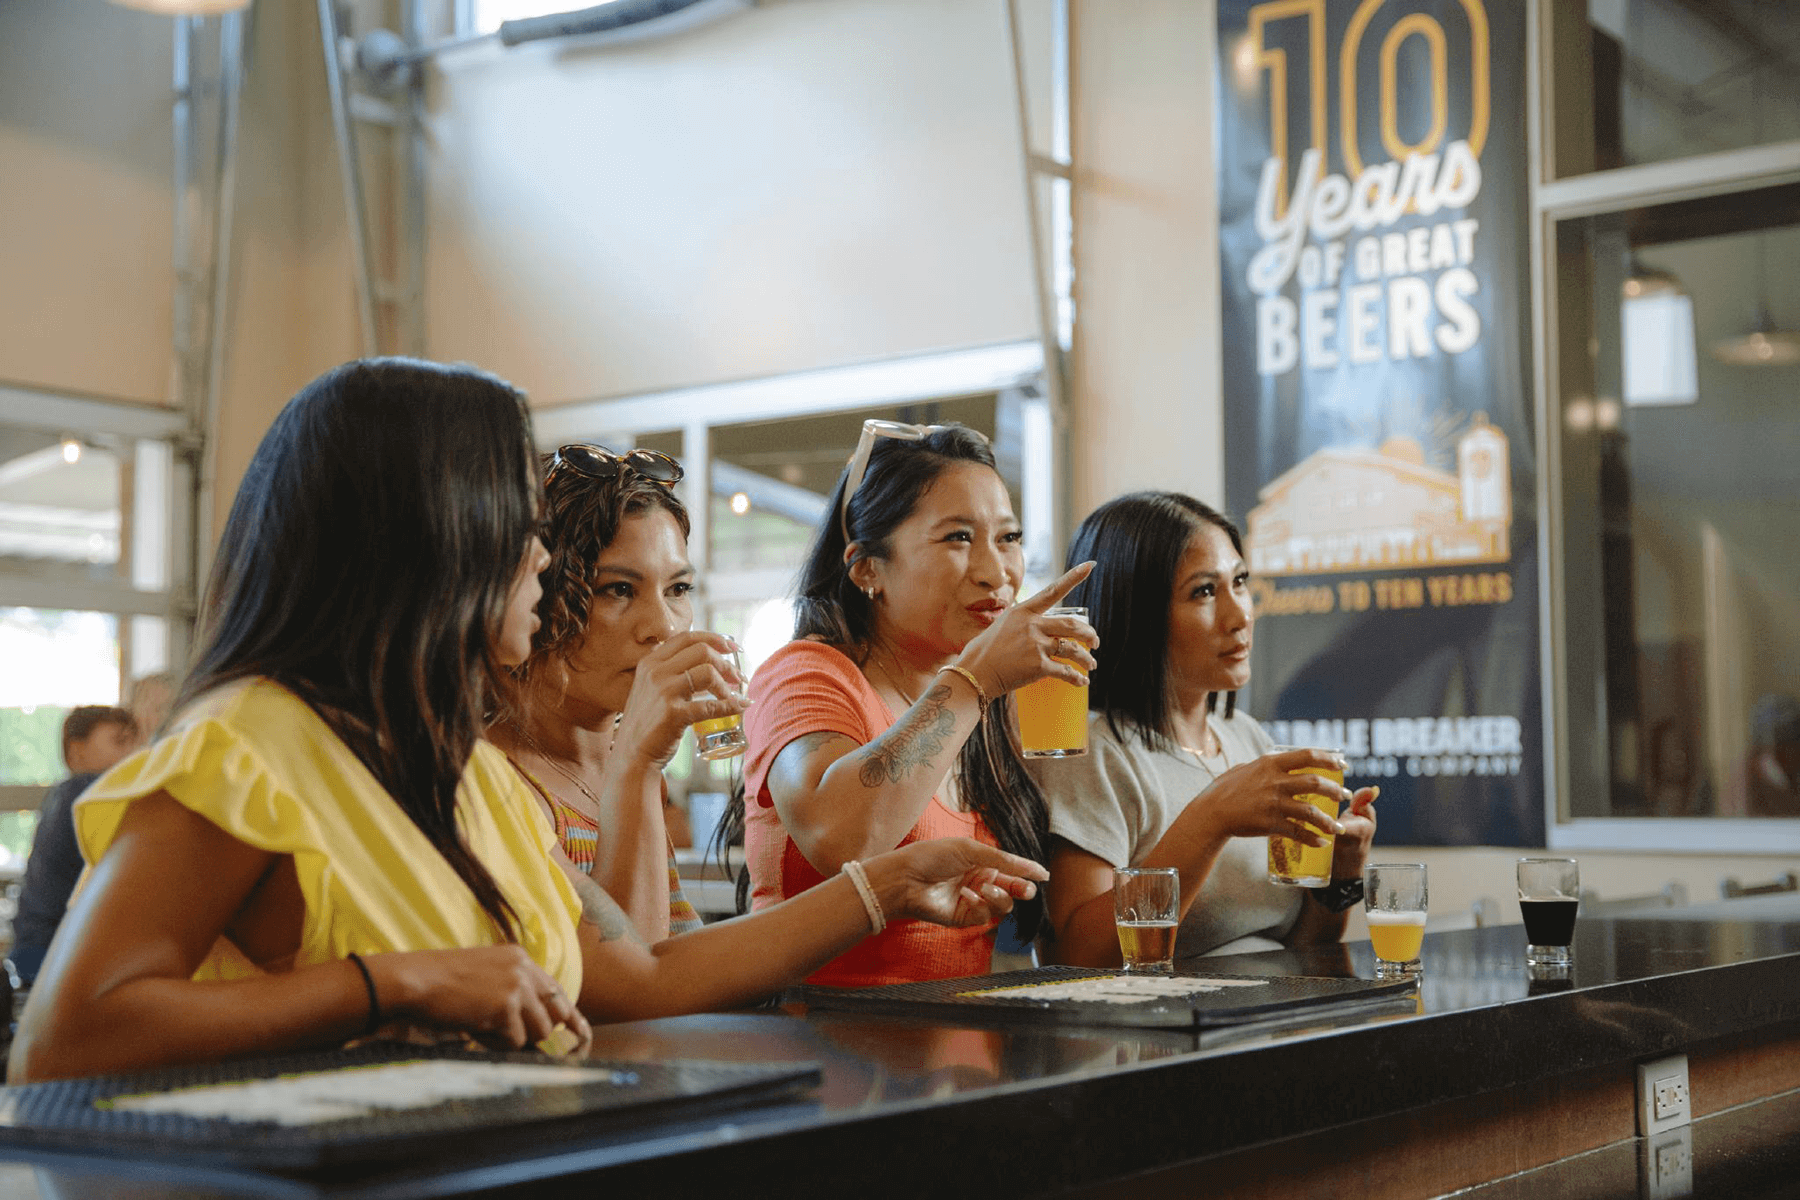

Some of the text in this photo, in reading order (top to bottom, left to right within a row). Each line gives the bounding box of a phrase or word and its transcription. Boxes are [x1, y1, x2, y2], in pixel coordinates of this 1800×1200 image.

[1247, 0, 1490, 214] 10
[1247, 139, 1482, 294] Years
[1299, 218, 1480, 289] OF GREAT
[1256, 267, 1481, 376] BEERS
[1338, 579, 1370, 612] TO
[1374, 577, 1424, 610] TEN
[1427, 571, 1513, 607] YEARS
[1372, 715, 1523, 758] BREAKER
[1405, 755, 1522, 777] COMPANY
